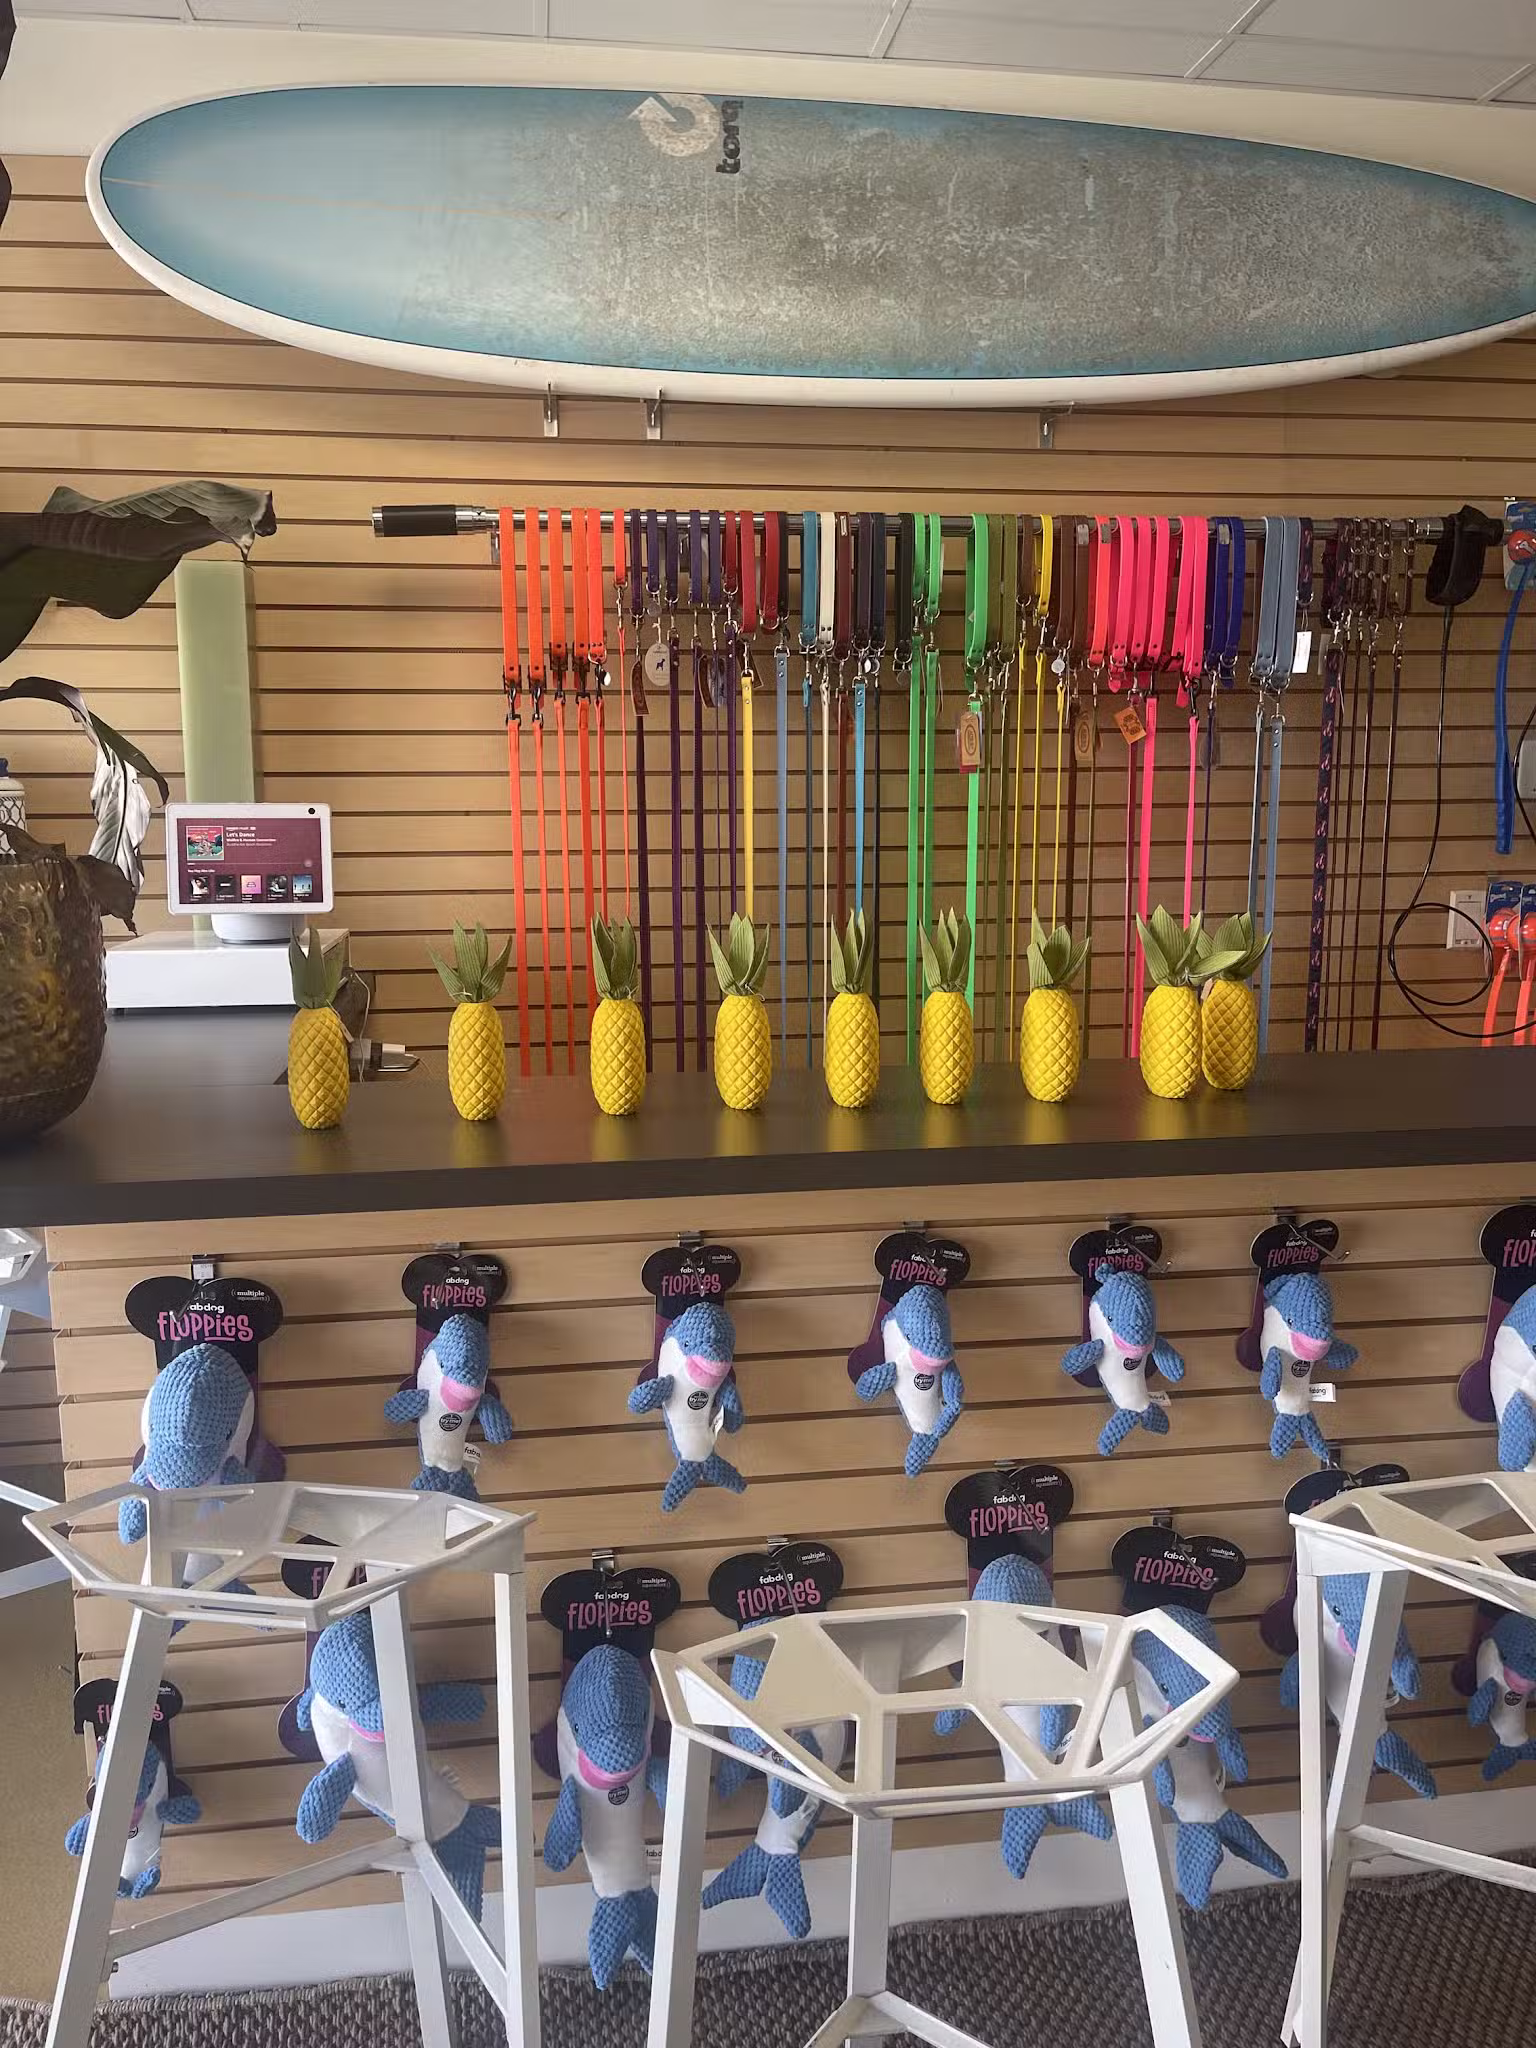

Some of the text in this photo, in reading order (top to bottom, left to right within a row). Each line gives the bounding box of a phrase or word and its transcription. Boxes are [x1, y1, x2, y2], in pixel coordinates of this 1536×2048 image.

[445, 1276, 470, 1285] abdog
[236, 1289, 265, 1297] multiple
[187, 1302, 225, 1314] abdog
[993, 1494, 1026, 1504] fabdg
[801, 1551, 826, 1561] multiple
[759, 1572, 793, 1584] fabdg
